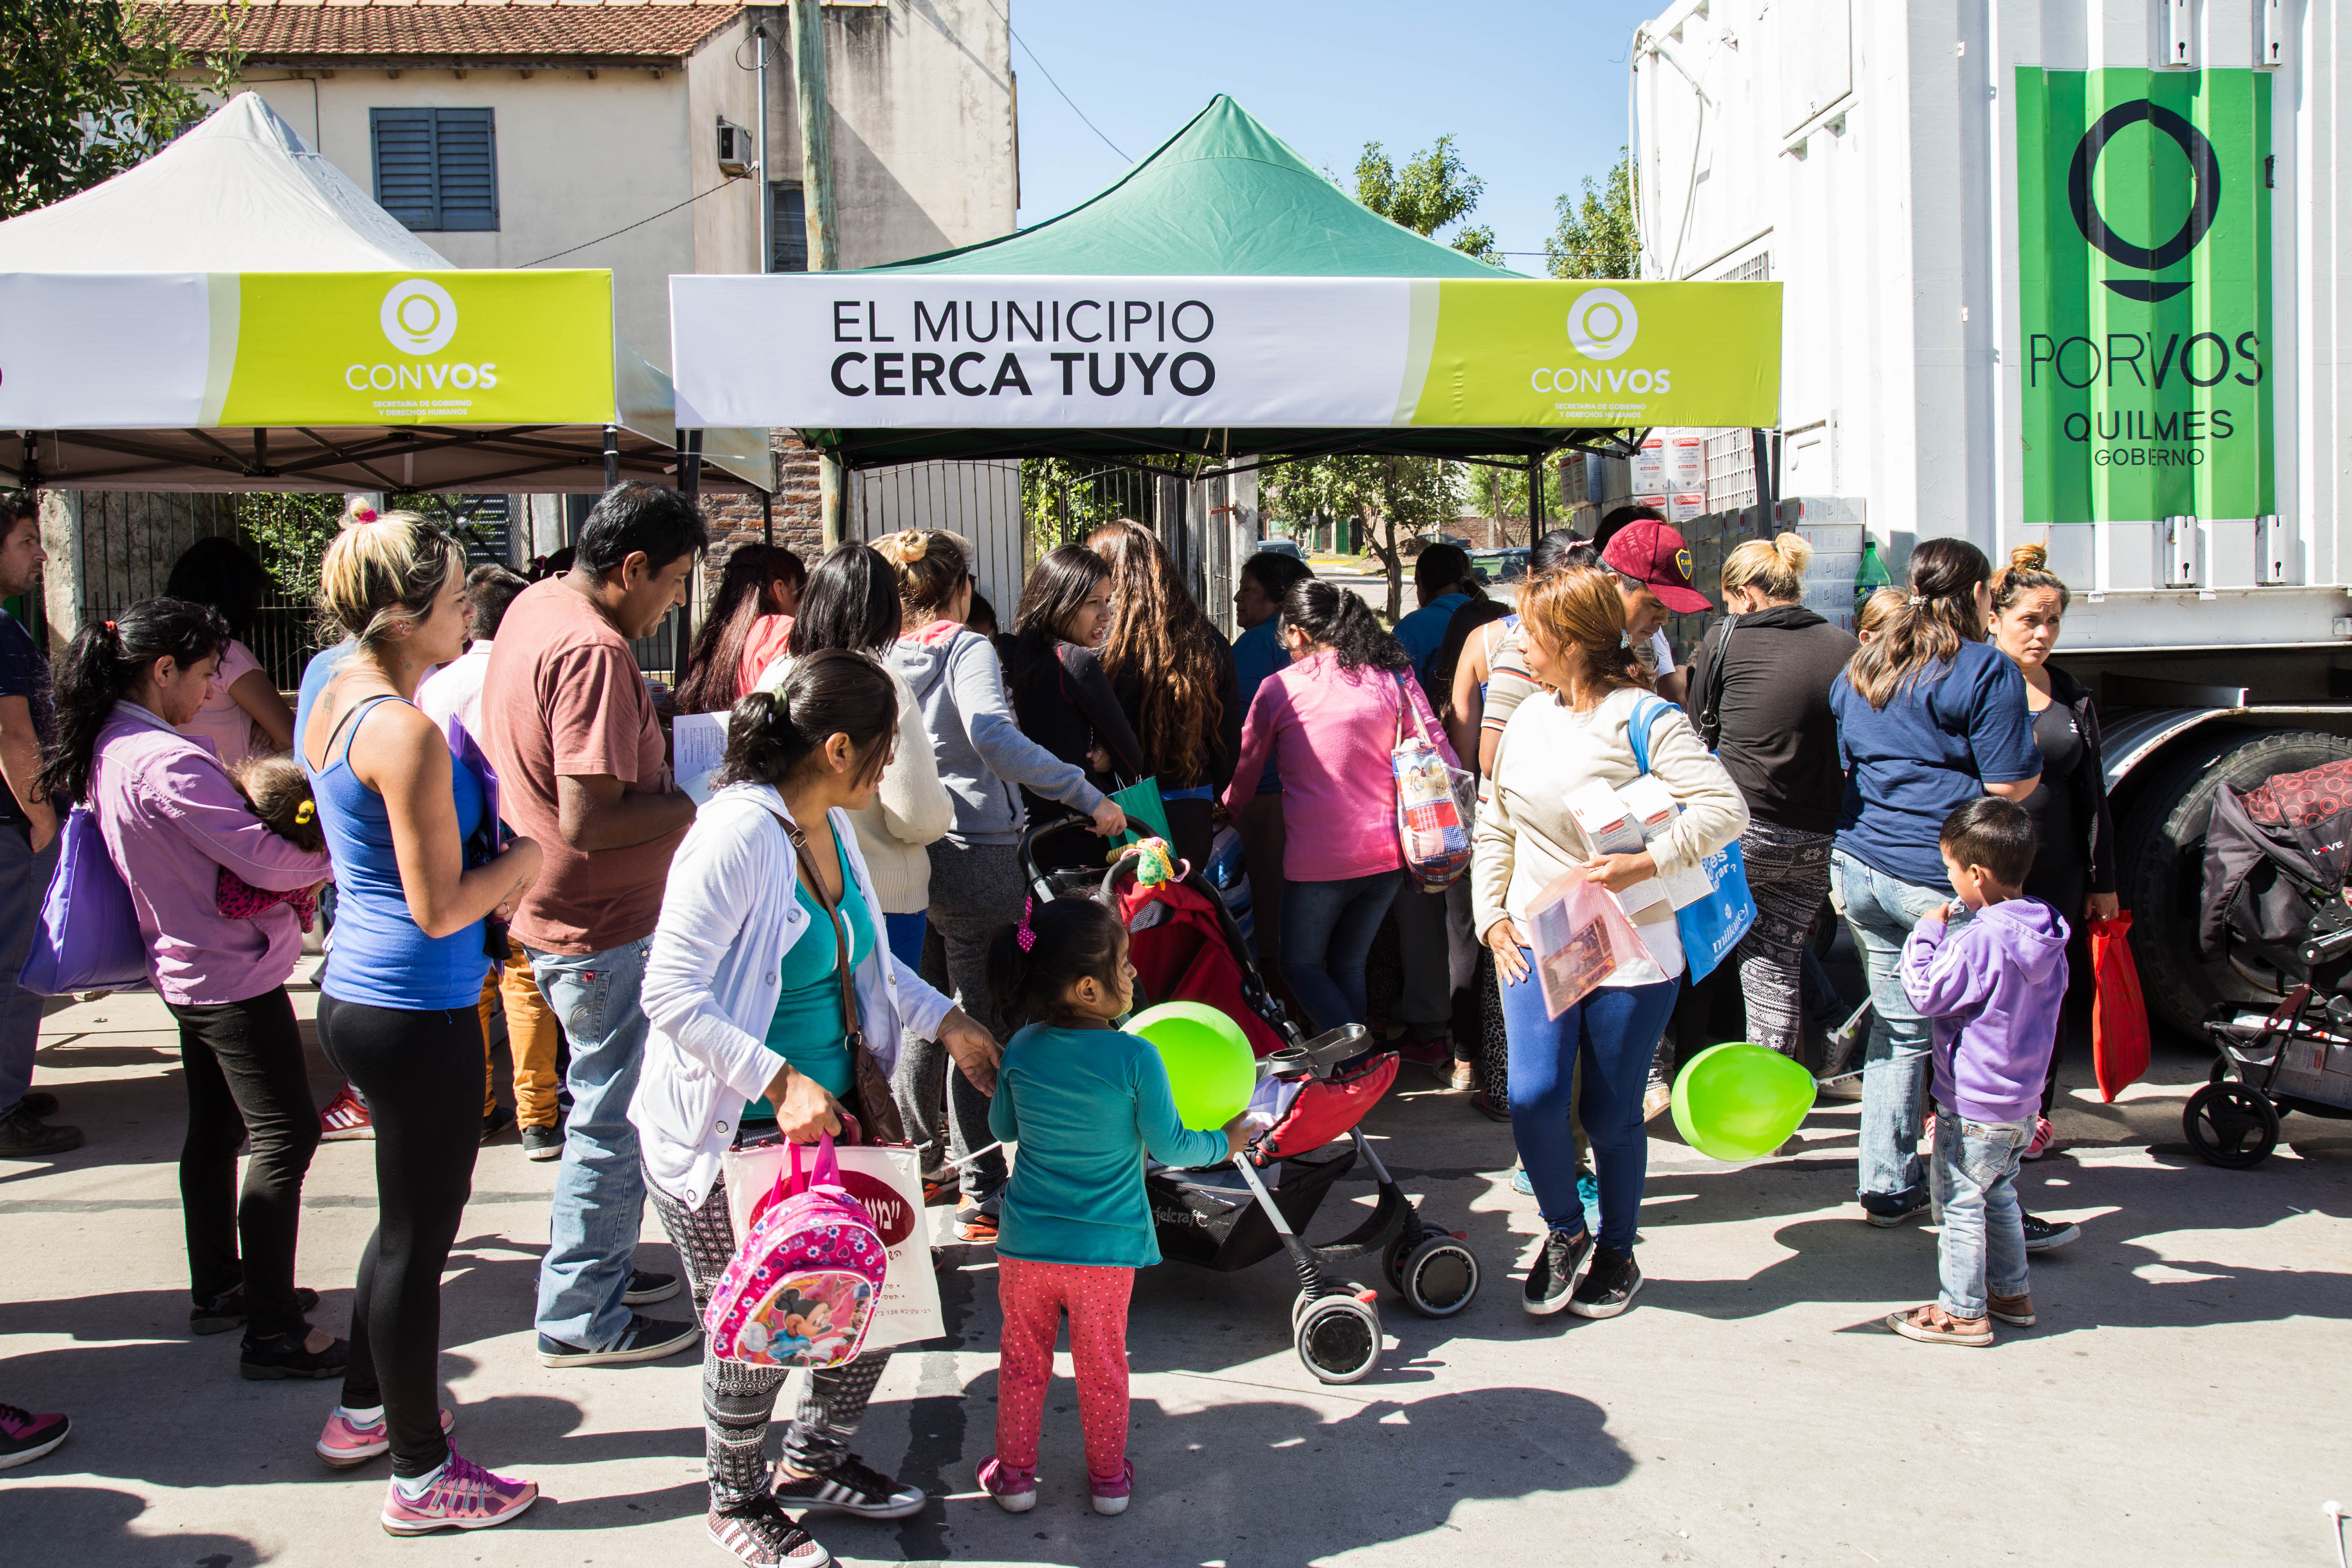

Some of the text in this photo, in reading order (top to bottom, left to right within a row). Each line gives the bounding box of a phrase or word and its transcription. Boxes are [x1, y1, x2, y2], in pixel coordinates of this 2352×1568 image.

[834, 300, 1214, 343] EL MUNICIPIO
[345, 363, 497, 391] CONVOS
[831, 352, 1215, 396] CERCA TUYO
[1531, 367, 1671, 394] CONVOS
[2064, 409, 2233, 442] QUILMES
